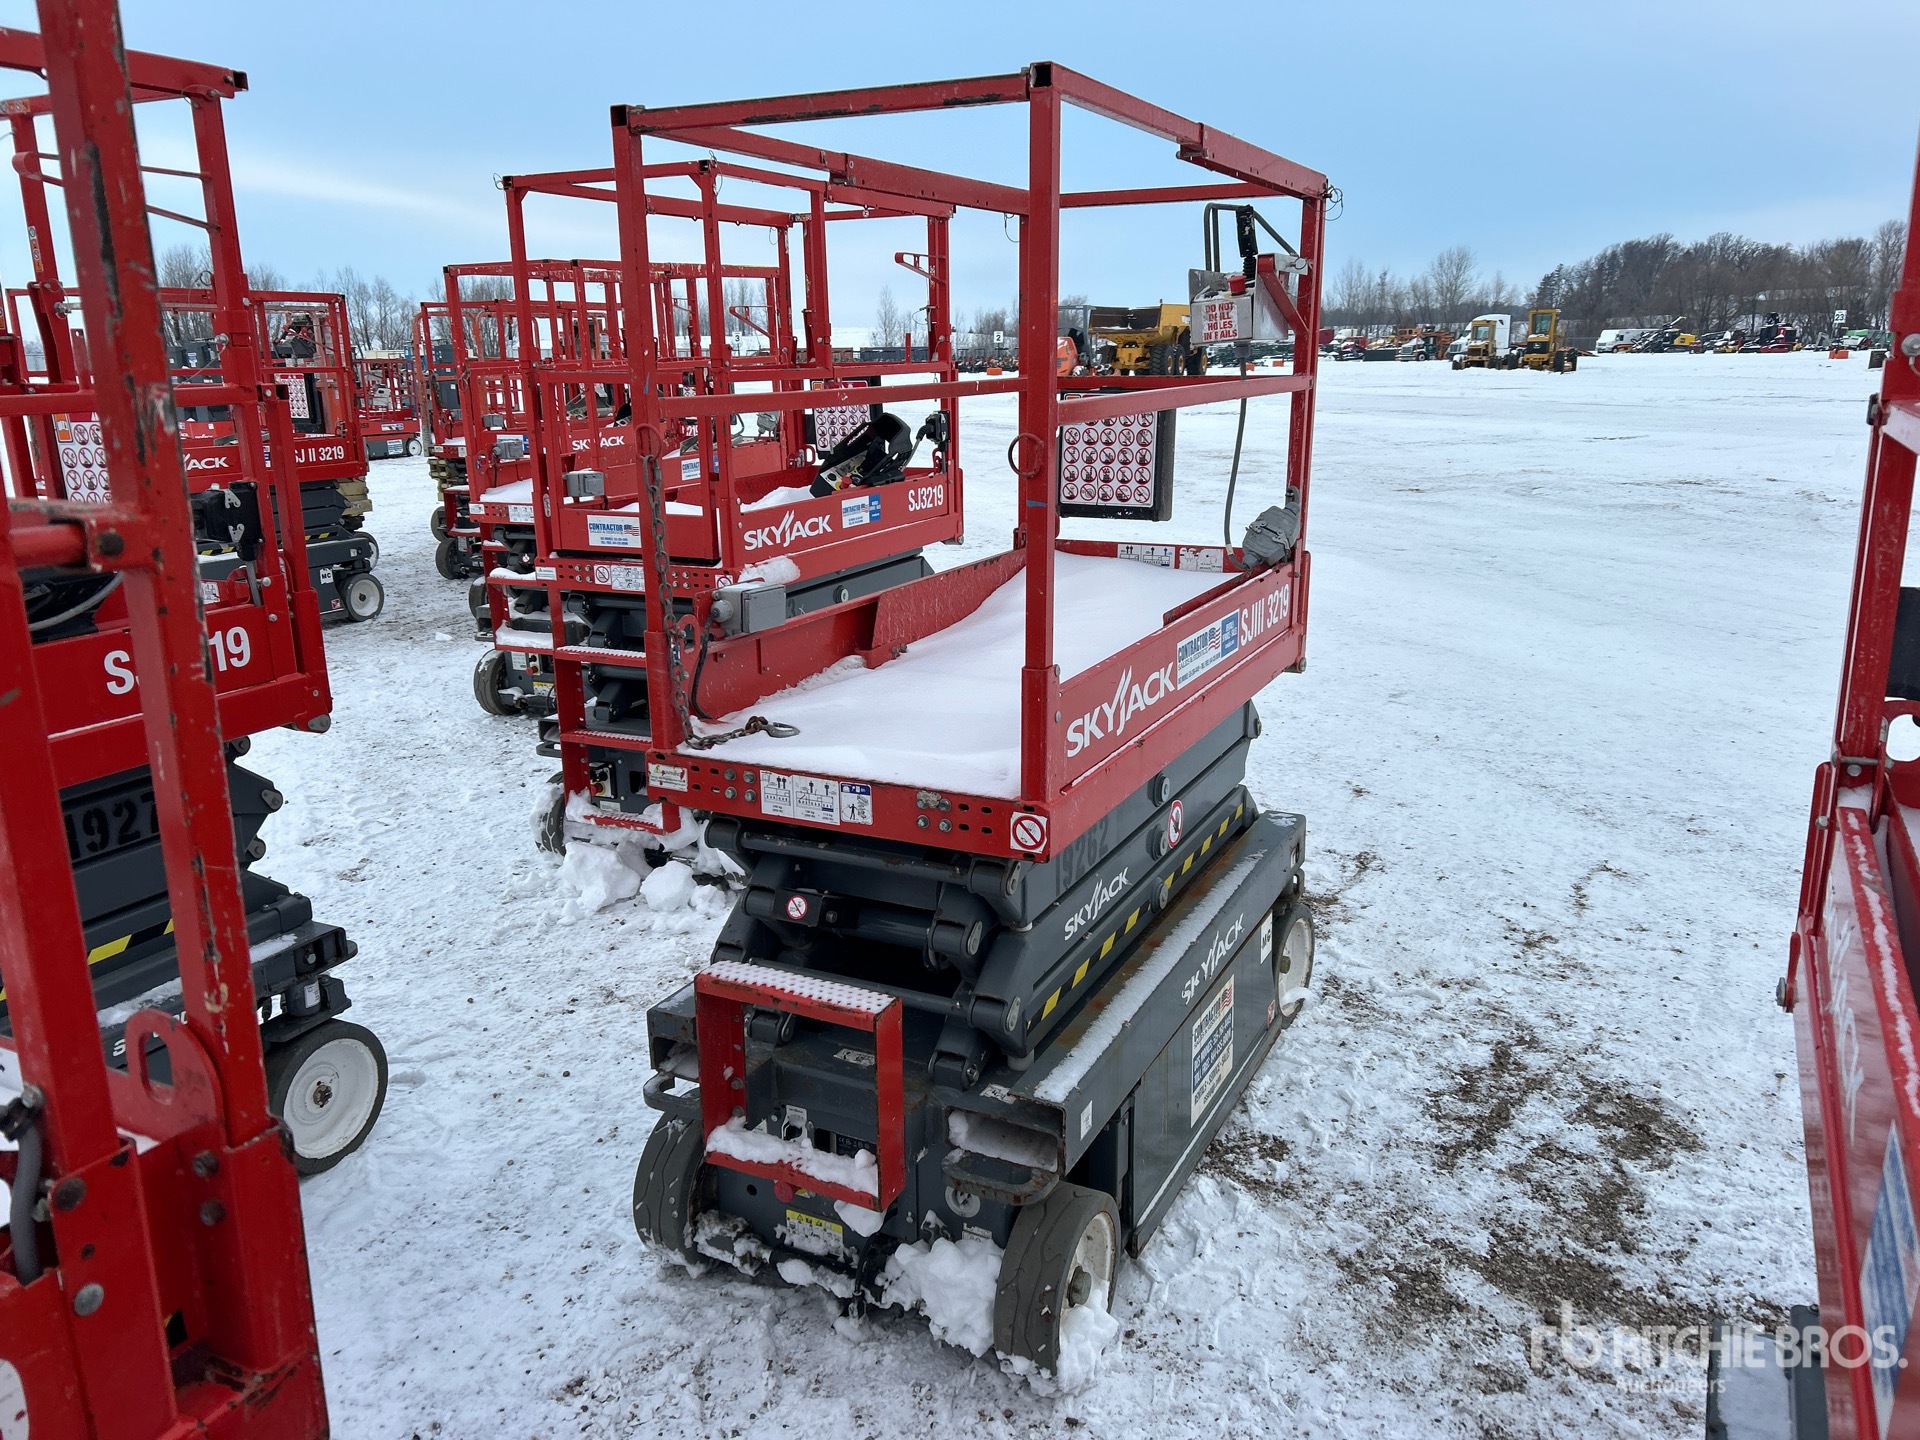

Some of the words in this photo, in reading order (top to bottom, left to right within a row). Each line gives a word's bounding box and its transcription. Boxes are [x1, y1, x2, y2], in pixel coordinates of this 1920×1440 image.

[1205, 304, 1216, 313] DO
[1218, 301, 1234, 311] NOT
[1835, 313, 1844, 321] 23
[1203, 332, 1212, 341] IN
[318, 445, 345, 461] 3219
[908, 484, 944, 512] SJ3219
[589, 523, 624, 531] CONTRACTOR
[743, 510, 833, 551] SKYJACK
[1267, 584, 1289, 629] 3219
[1066, 665, 1176, 757] SKYJACK
[1064, 866, 1133, 942] SKYJACK
[1181, 912, 1245, 1006] SKYJACK
